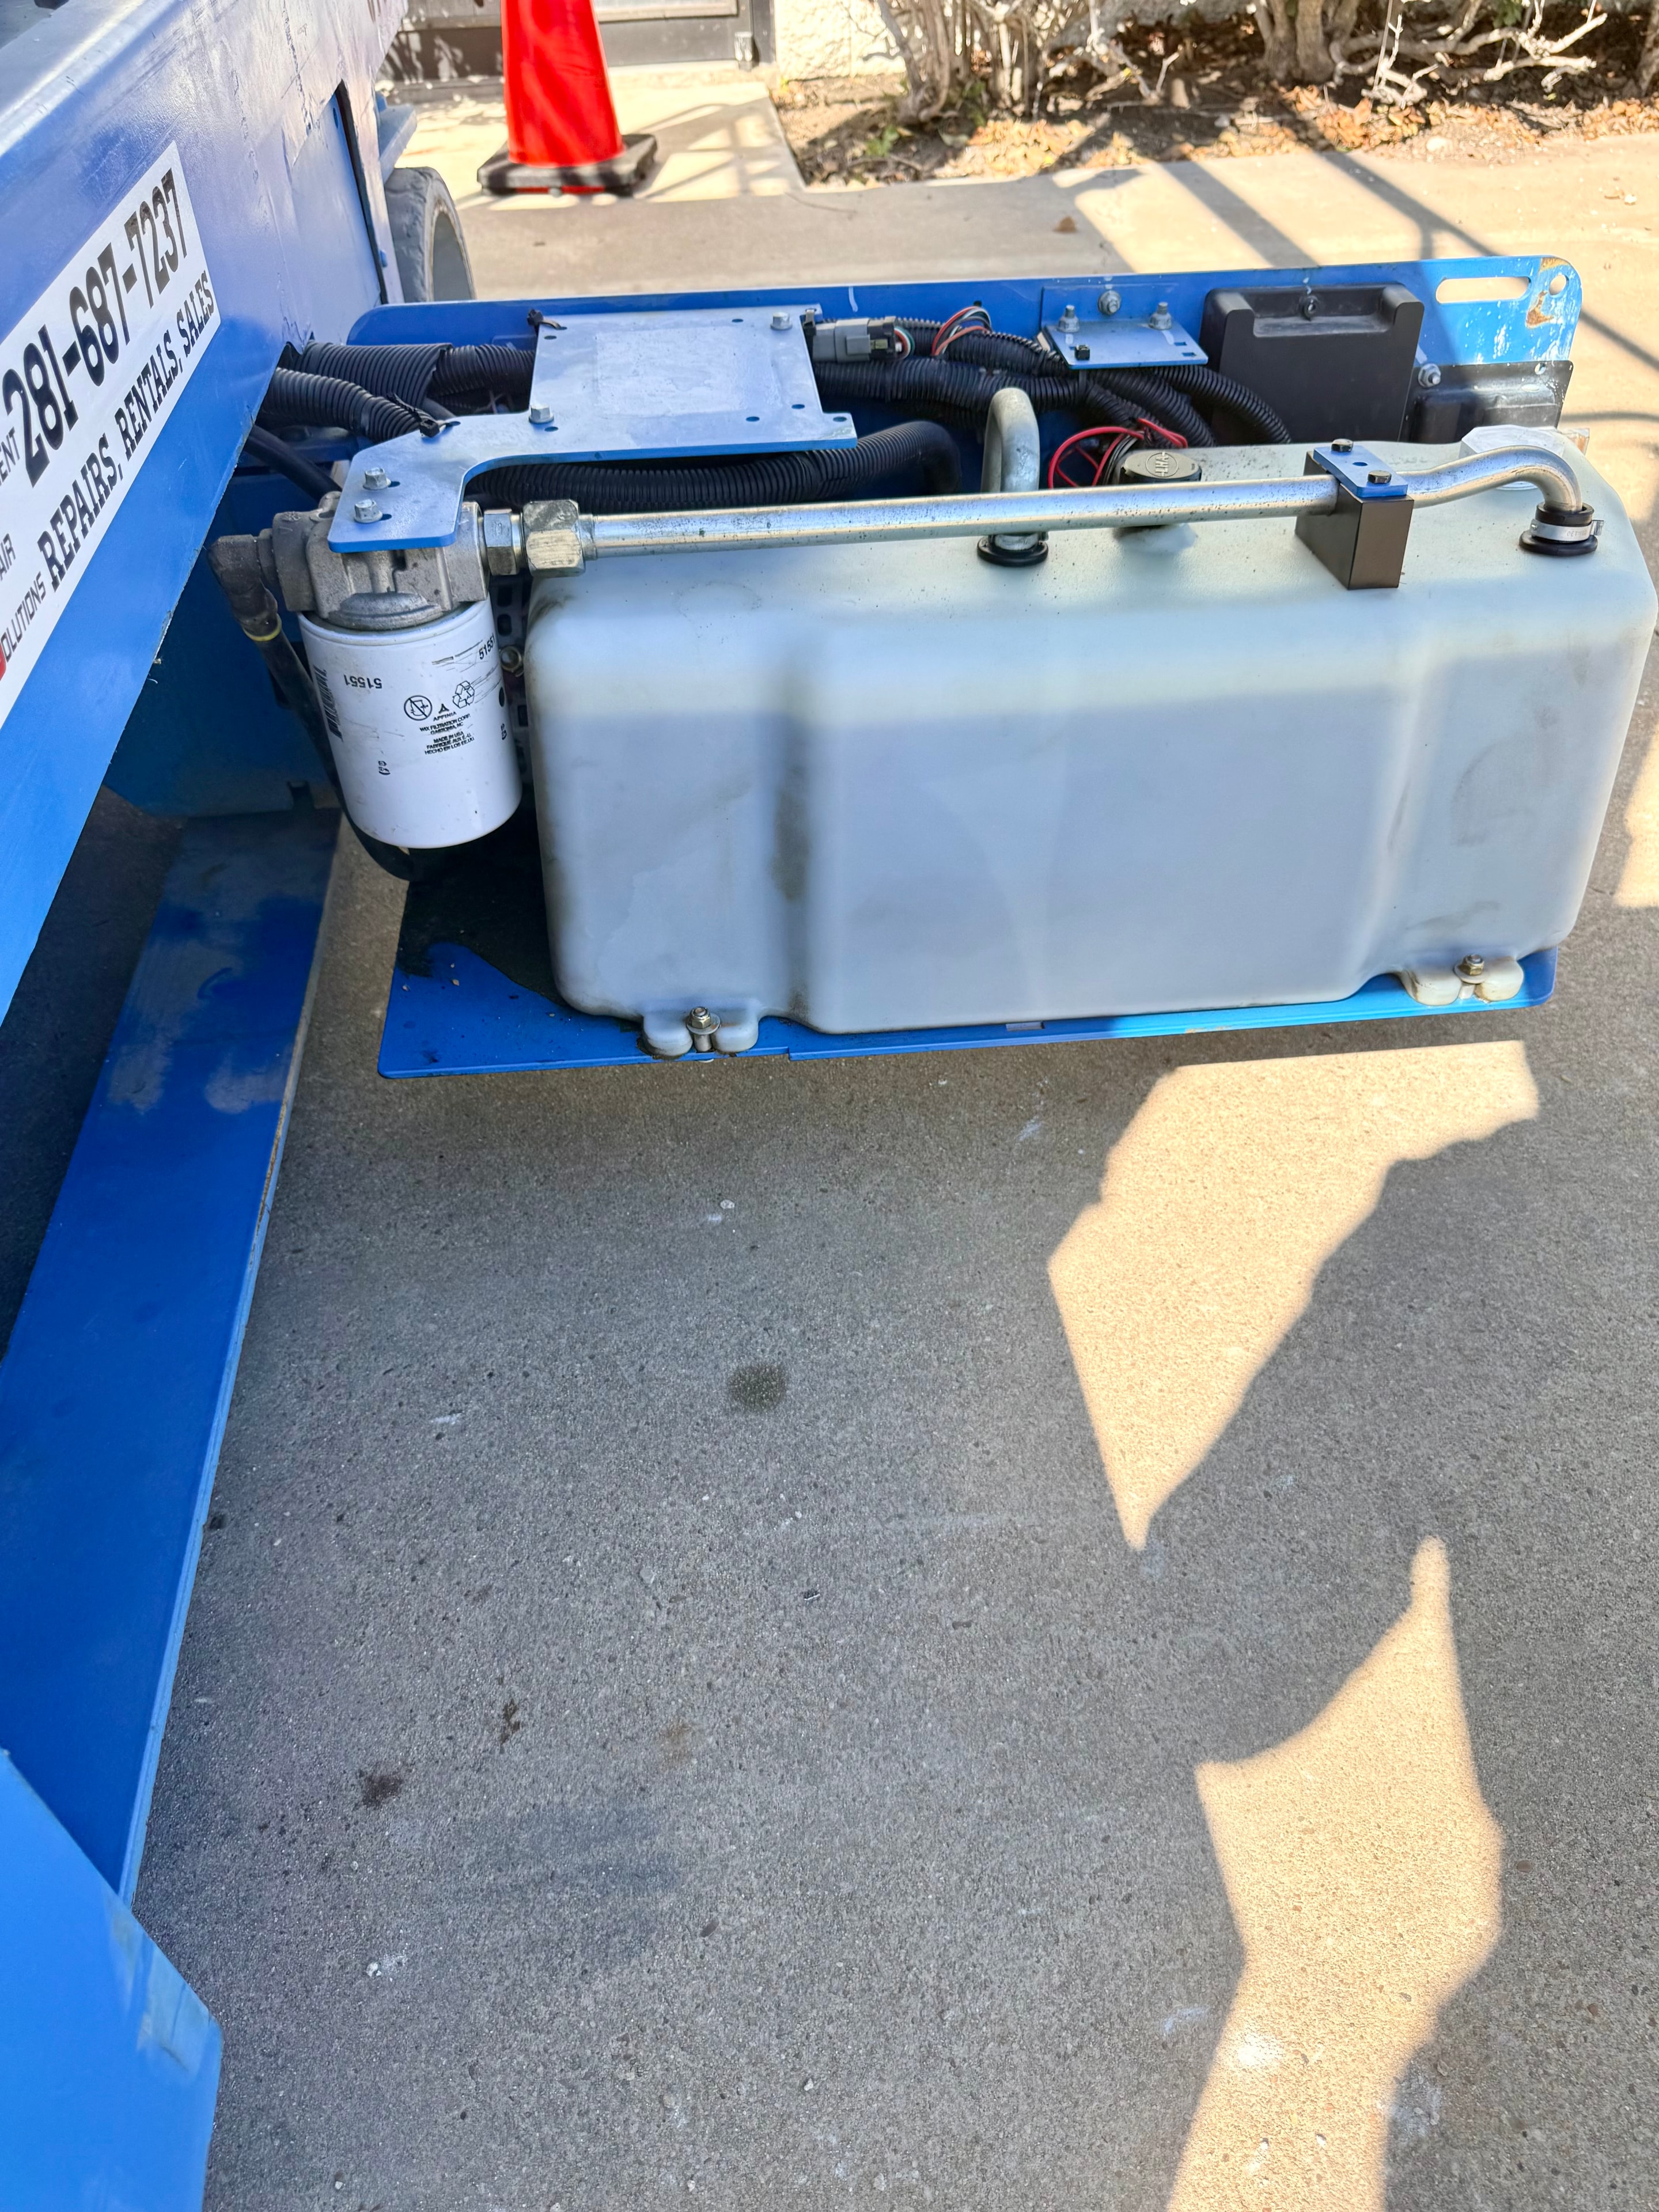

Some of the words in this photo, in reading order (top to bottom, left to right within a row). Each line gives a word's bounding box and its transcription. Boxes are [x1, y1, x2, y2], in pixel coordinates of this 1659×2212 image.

[2, 167, 187, 488] 281-687-7237
[0, 427, 20, 486] ENT
[37, 433, 123, 593] REPAIRS,
[115, 329, 184, 461] RENTALS,
[176, 270, 215, 358] SALES
[344, 675, 382, 689] 51551
[433, 711, 457, 721] AFFINIA
